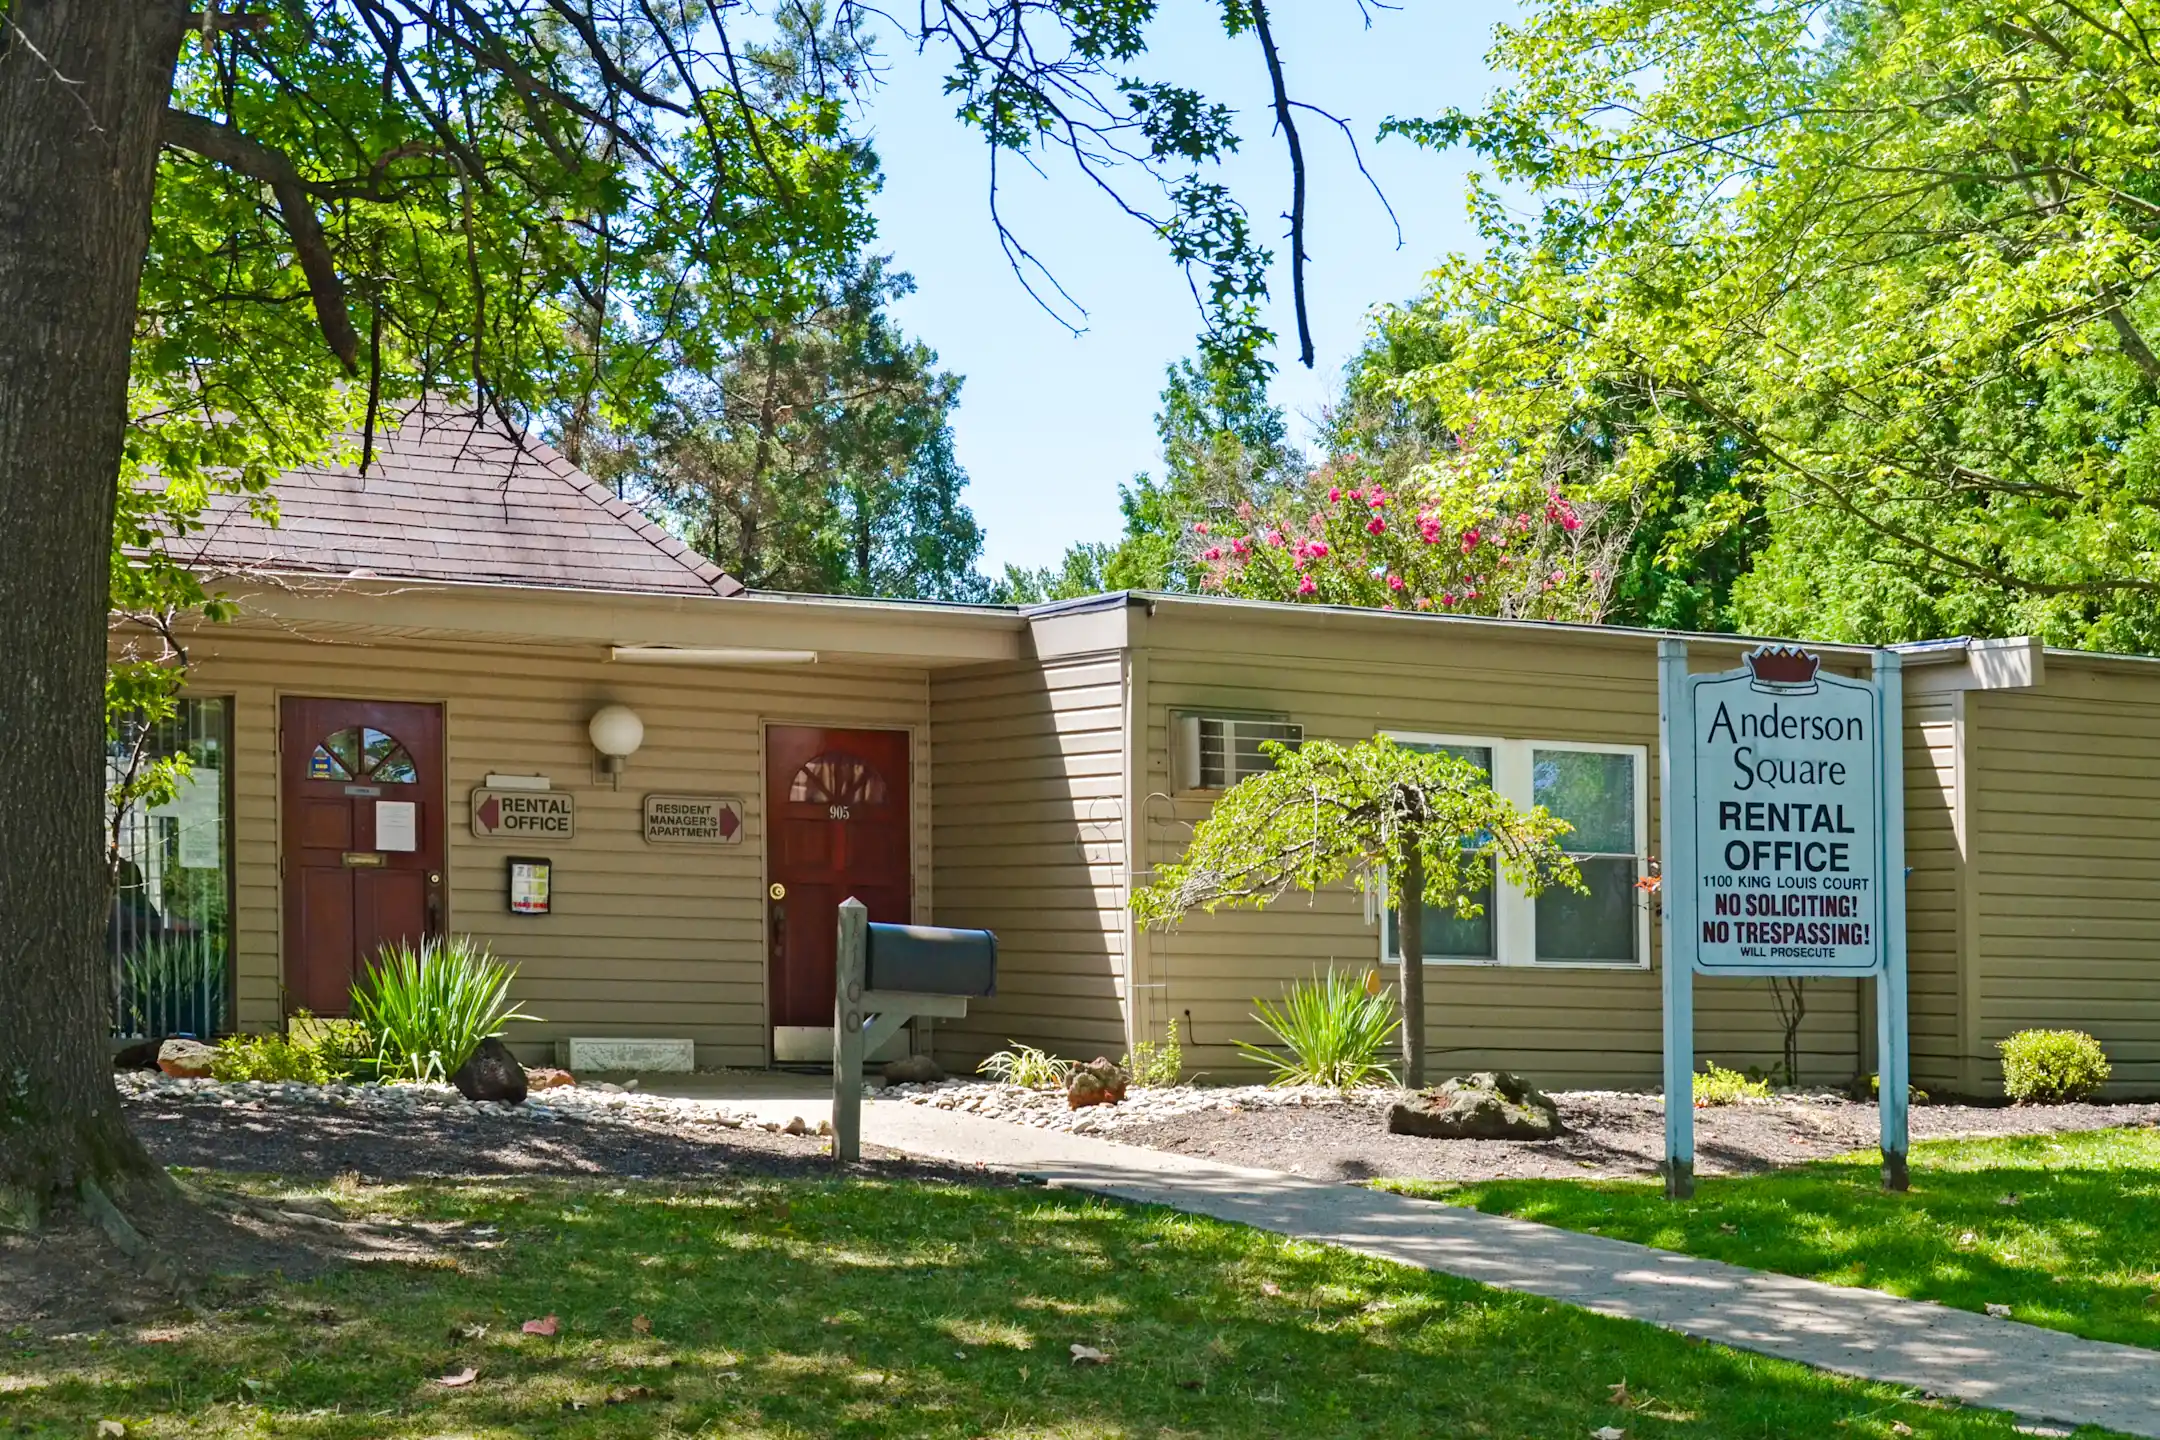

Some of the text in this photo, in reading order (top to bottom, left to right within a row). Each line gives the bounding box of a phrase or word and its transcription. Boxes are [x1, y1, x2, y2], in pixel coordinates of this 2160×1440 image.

[1707, 701, 1863, 744] Anderson
[1733, 747, 1846, 790] Square
[501, 798, 571, 814] RENTAL
[655, 803, 711, 815] RESIDENT
[829, 805, 850, 820] 905
[504, 815, 569, 831] OFFICE
[650, 815, 718, 827] MANAGER'S
[1719, 801, 1855, 833] RENTAL
[650, 826, 718, 838] APARTMENT
[1724, 840, 1850, 872] OFFICE
[1703, 875, 1869, 890] 1100 KING LOUIS COURT
[1715, 893, 1858, 918] NO SOLICITING!
[1703, 921, 1870, 945] NO TRESPASSING!
[1740, 947, 1836, 958] WILL PROSECUTE
